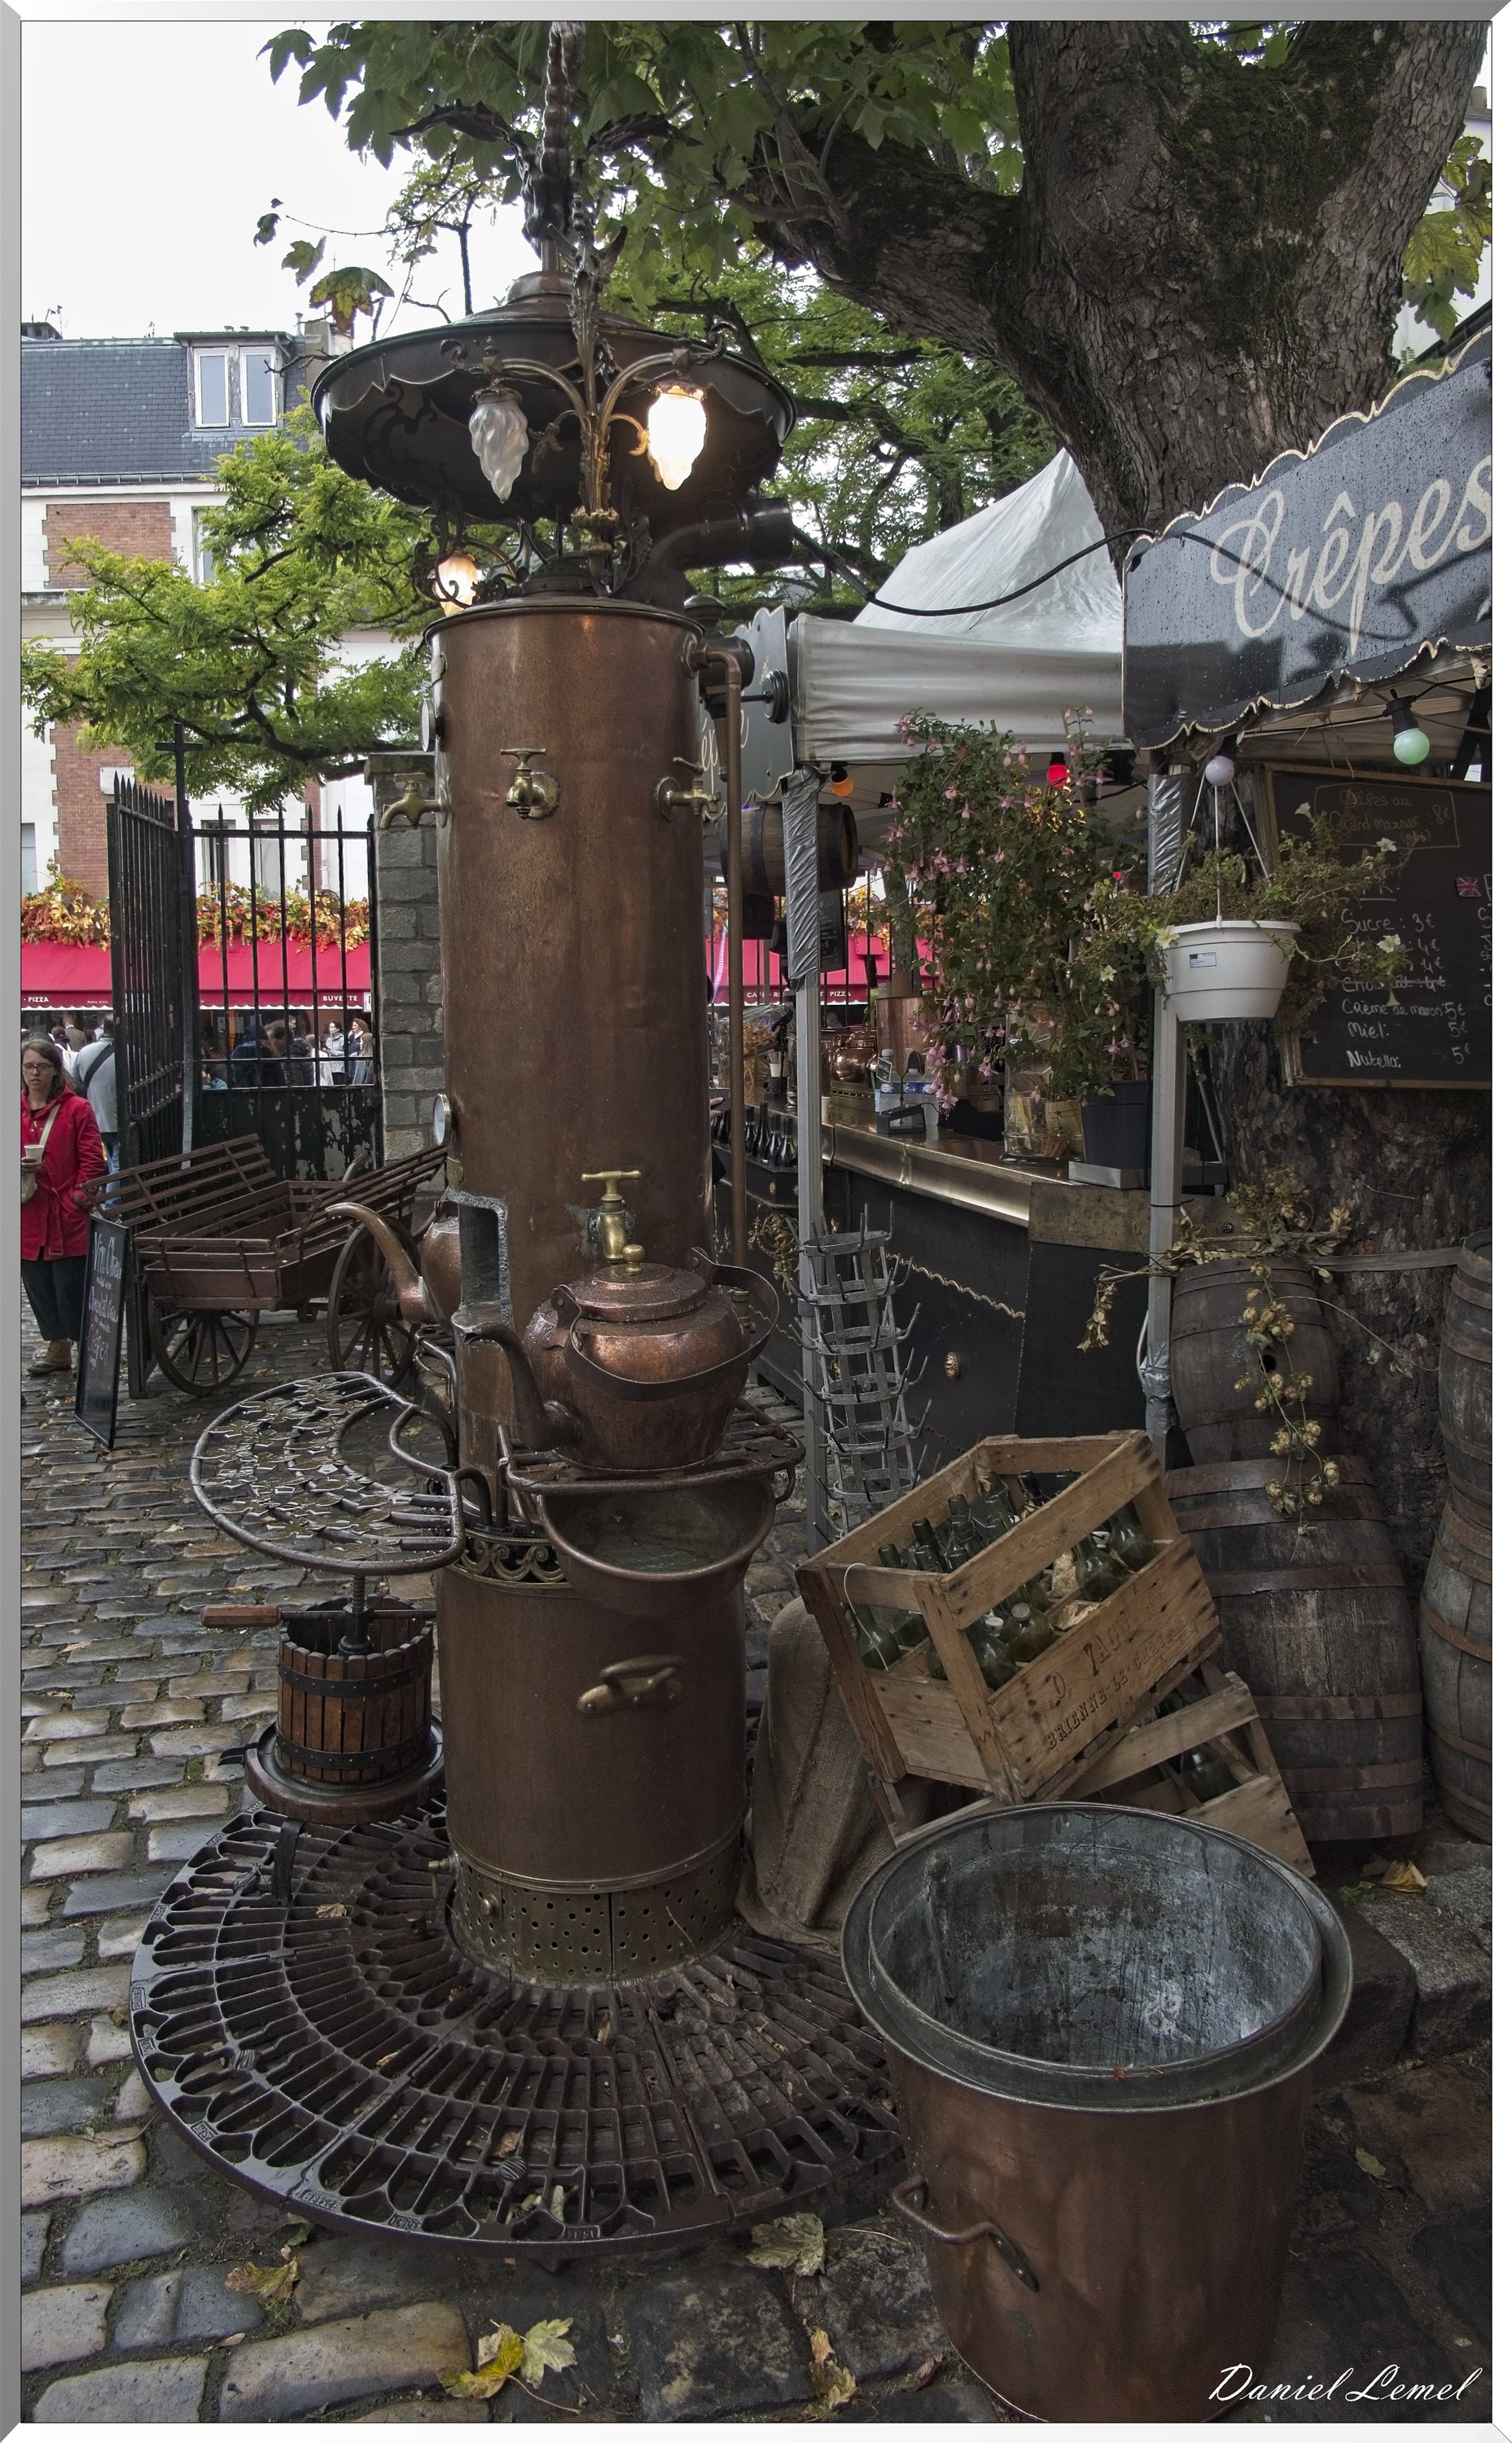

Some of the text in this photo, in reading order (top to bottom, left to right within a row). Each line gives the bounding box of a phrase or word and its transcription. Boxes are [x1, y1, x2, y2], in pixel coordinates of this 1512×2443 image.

[1211, 453, 1492, 656] Crêpes
[1412, 913, 1435, 932] 3€
[1448, 1020, 1468, 1038] 5€
[1452, 1042, 1471, 1065] 5€
